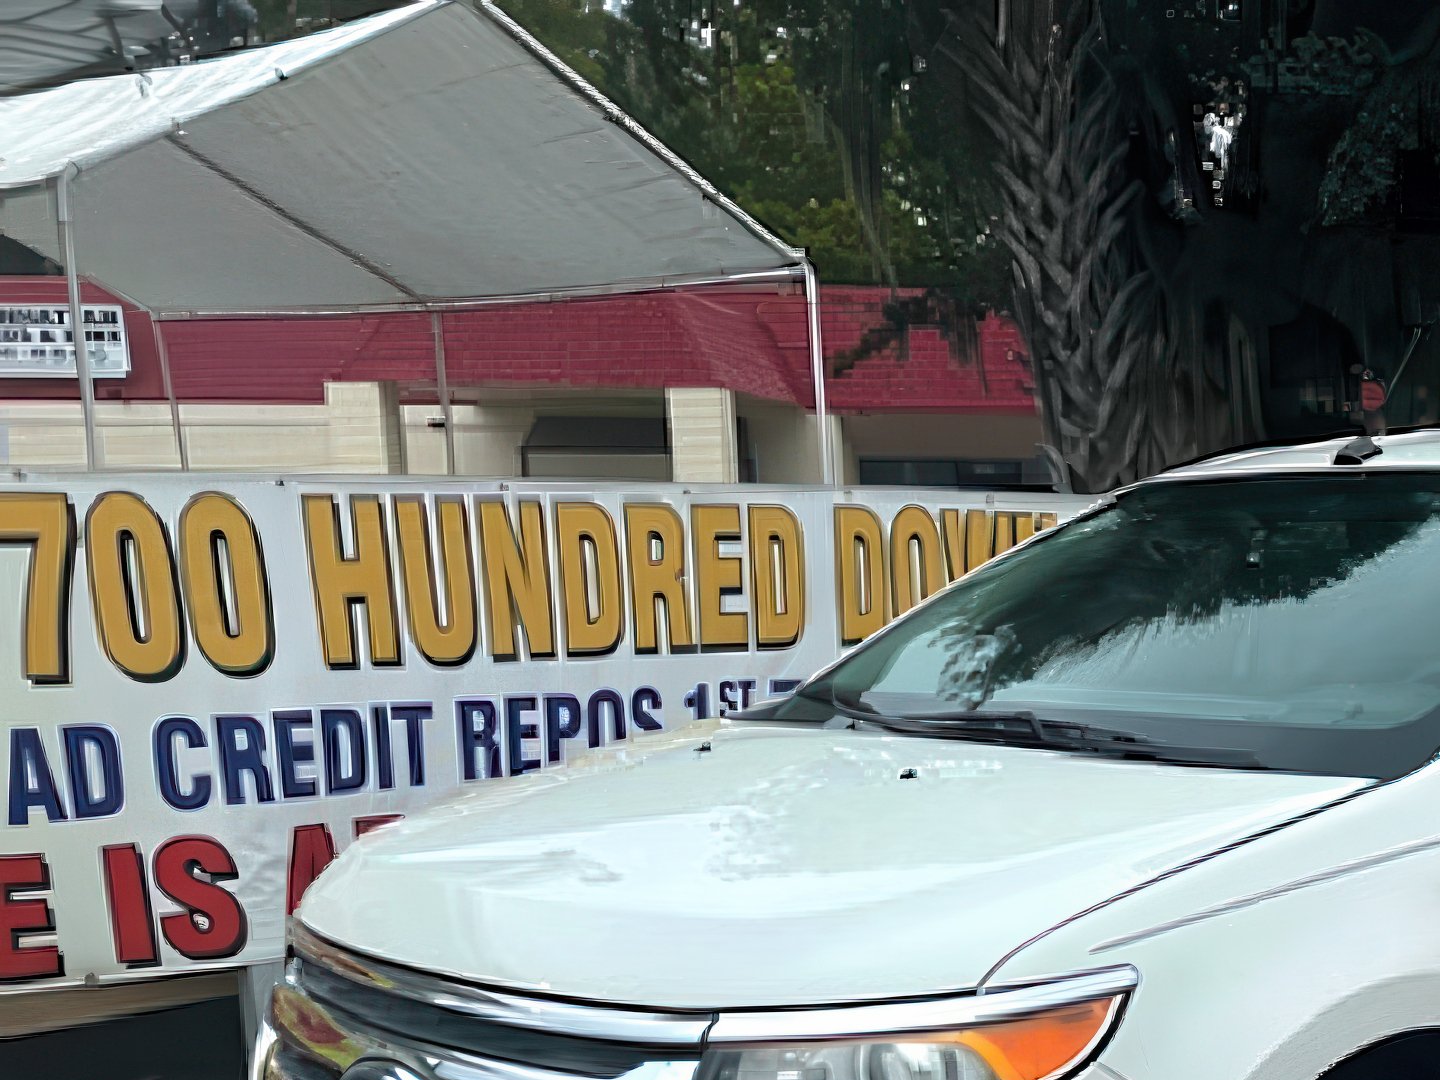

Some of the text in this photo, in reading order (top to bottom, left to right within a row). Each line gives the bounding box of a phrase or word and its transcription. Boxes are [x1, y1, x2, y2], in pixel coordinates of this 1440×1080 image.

[0, 490, 1057, 685] 700 HUNDRED DO
[8, 725, 124, 825] AD
[153, 704, 433, 811] CREDIT
[102, 834, 247, 969] IS
